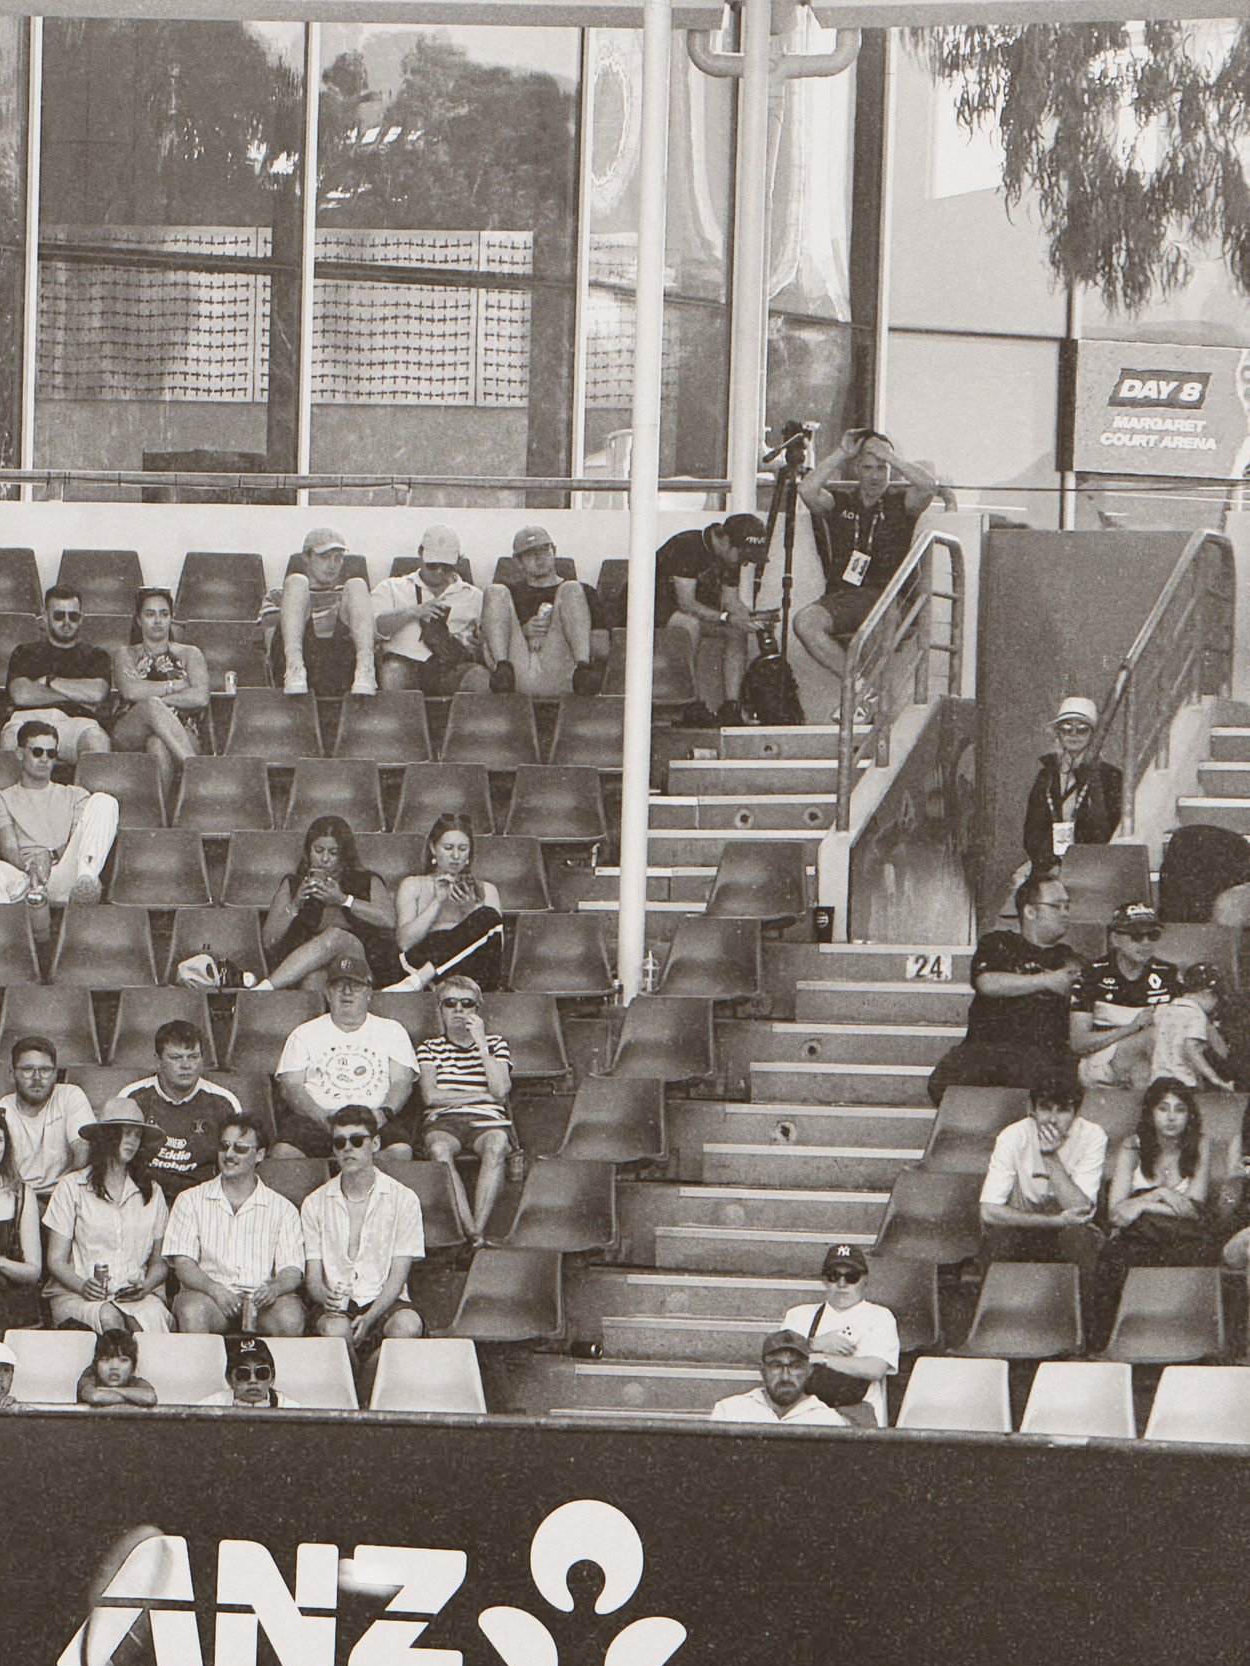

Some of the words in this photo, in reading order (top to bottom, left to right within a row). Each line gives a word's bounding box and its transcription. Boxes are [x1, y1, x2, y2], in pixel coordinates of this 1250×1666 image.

[1119, 379, 1179, 399] DAY
[1179, 382, 1202, 402] 8
[1112, 415, 1207, 433] MARGARET
[1100, 432, 1159, 448] COURT
[1159, 436, 1217, 450] ARENA
[914, 954, 944, 979] 24
[157, 1147, 192, 1160] Eddie
